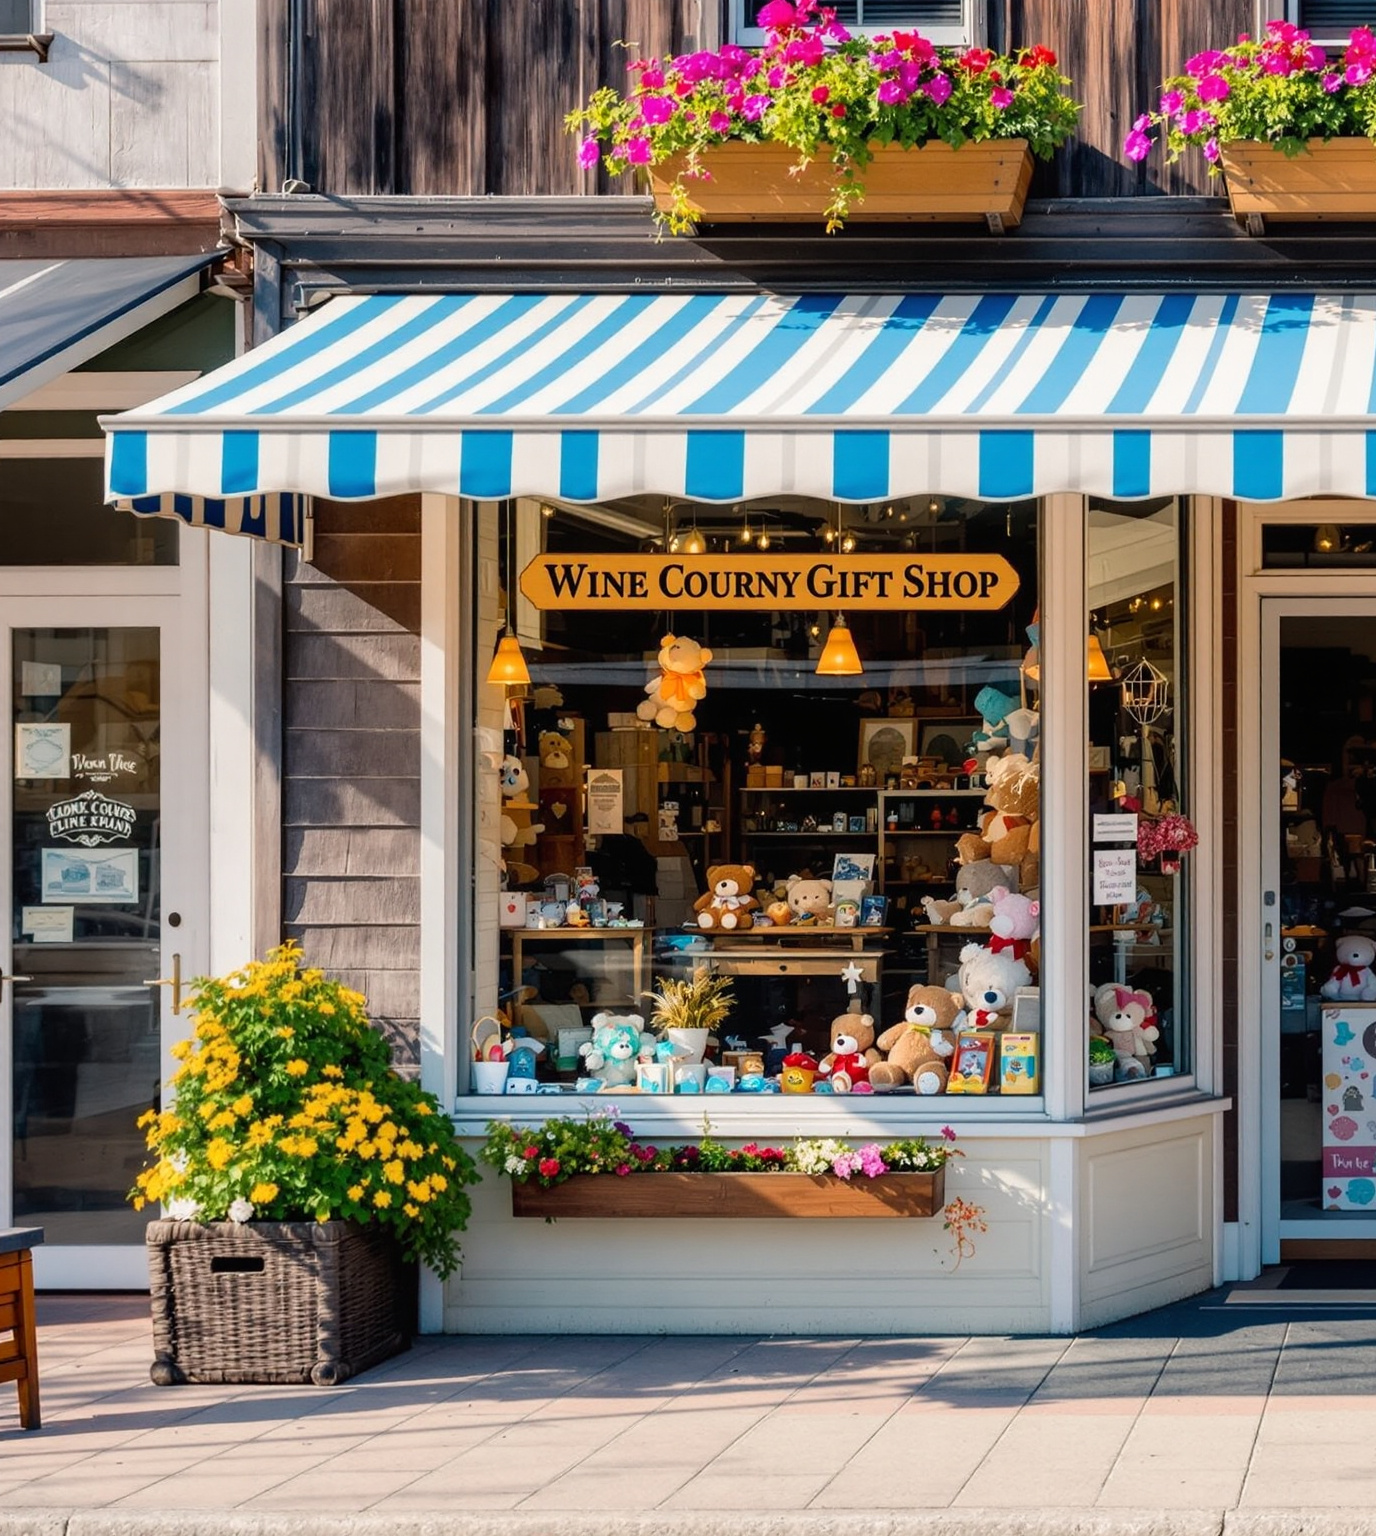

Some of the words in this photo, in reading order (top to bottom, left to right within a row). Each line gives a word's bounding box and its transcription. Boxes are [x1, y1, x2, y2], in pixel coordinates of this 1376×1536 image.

[544, 563, 648, 598] WINE
[806, 563, 893, 598] GIFT
[903, 563, 999, 598] SHOP
